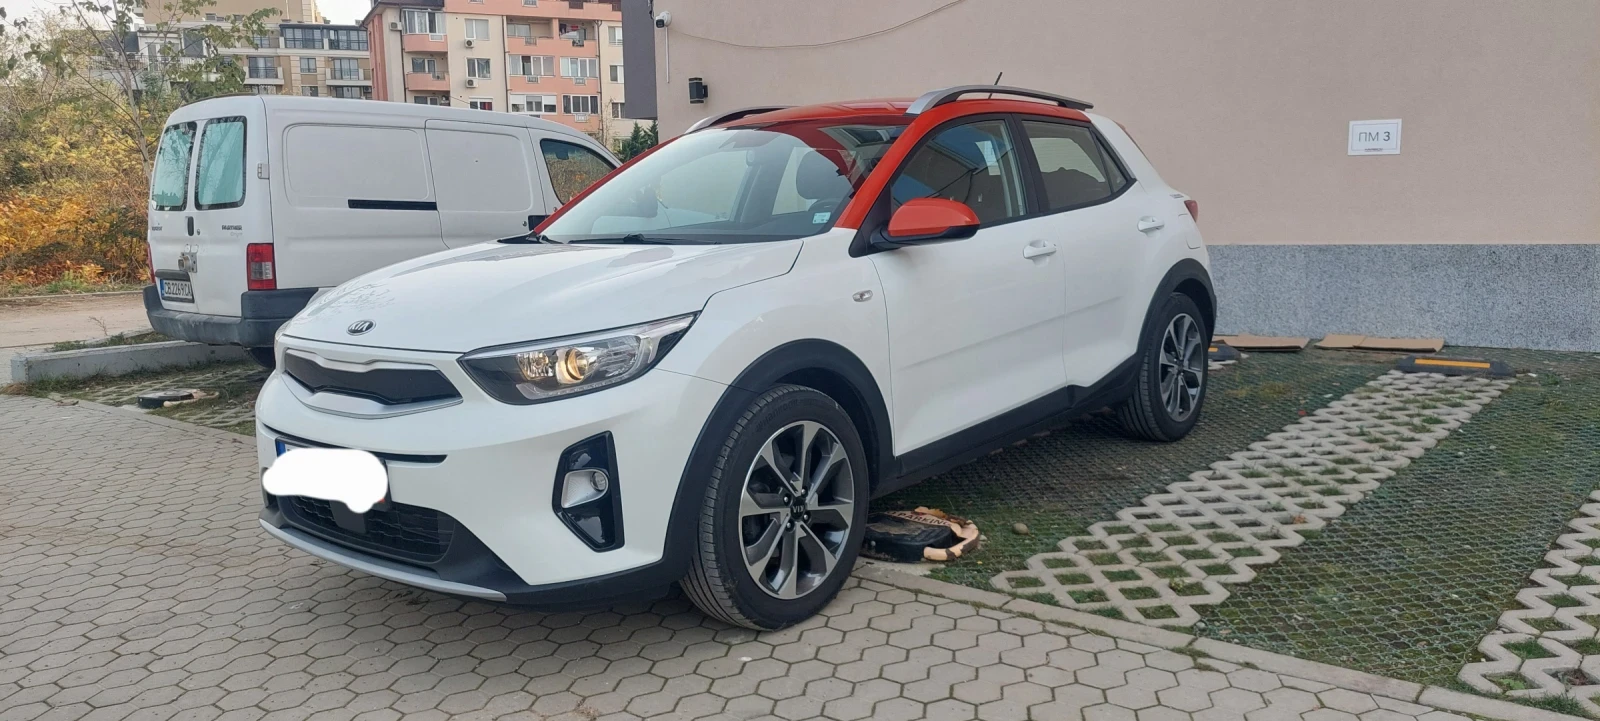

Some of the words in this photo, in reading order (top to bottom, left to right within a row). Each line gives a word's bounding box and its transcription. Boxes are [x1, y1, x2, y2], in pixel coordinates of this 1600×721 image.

[1358, 131, 1379, 142] ПМ
[1383, 131, 1391, 142] 3
[348, 321, 370, 331] KIA
